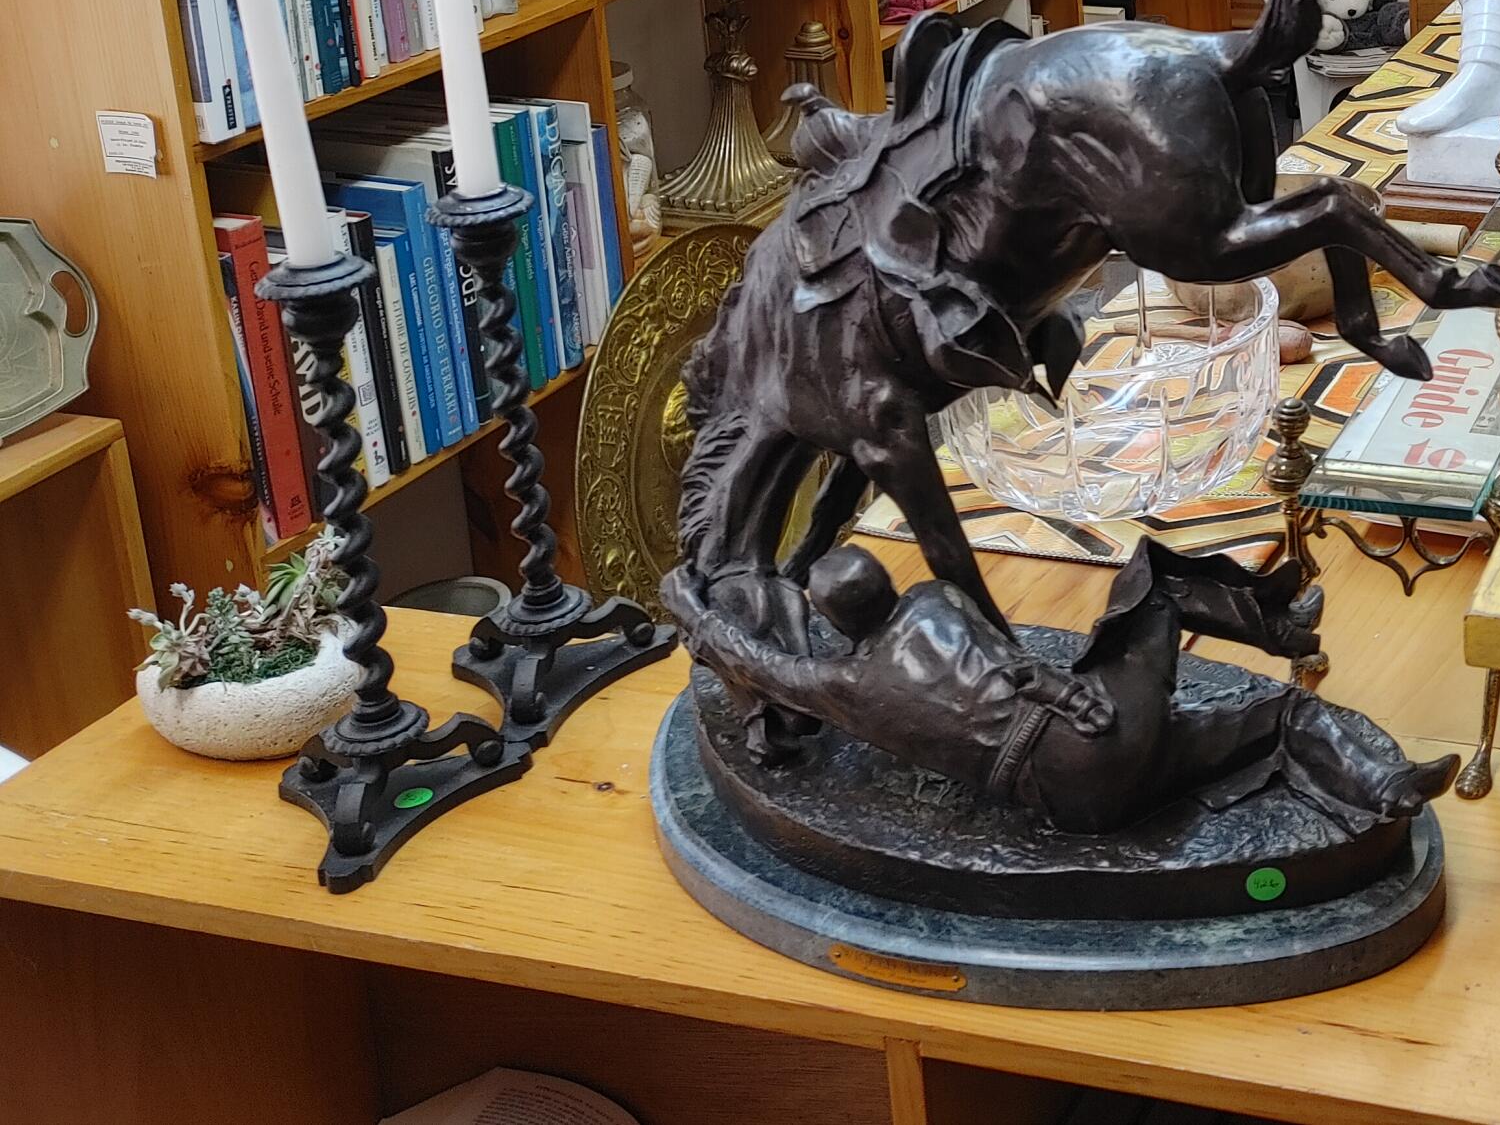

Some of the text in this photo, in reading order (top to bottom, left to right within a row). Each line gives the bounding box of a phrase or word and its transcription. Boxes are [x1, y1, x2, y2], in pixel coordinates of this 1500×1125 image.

[224, 94, 236, 130] PRESTEL
[546, 120, 568, 207] DEGAS
[443, 247, 454, 278] Degas
[521, 222, 535, 280] Degas Pastels
[540, 241, 549, 271] Pastels
[230, 295, 241, 322] KARIN
[375, 286, 388, 339] Giorgio Chirico
[421, 256, 457, 415] GREGORIO DE FERRARI
[255, 298, 282, 416] David und seine Schule
[392, 298, 416, 411] ETTORE DE CONCILIIS
[1400, 347, 1495, 470] Guide to
